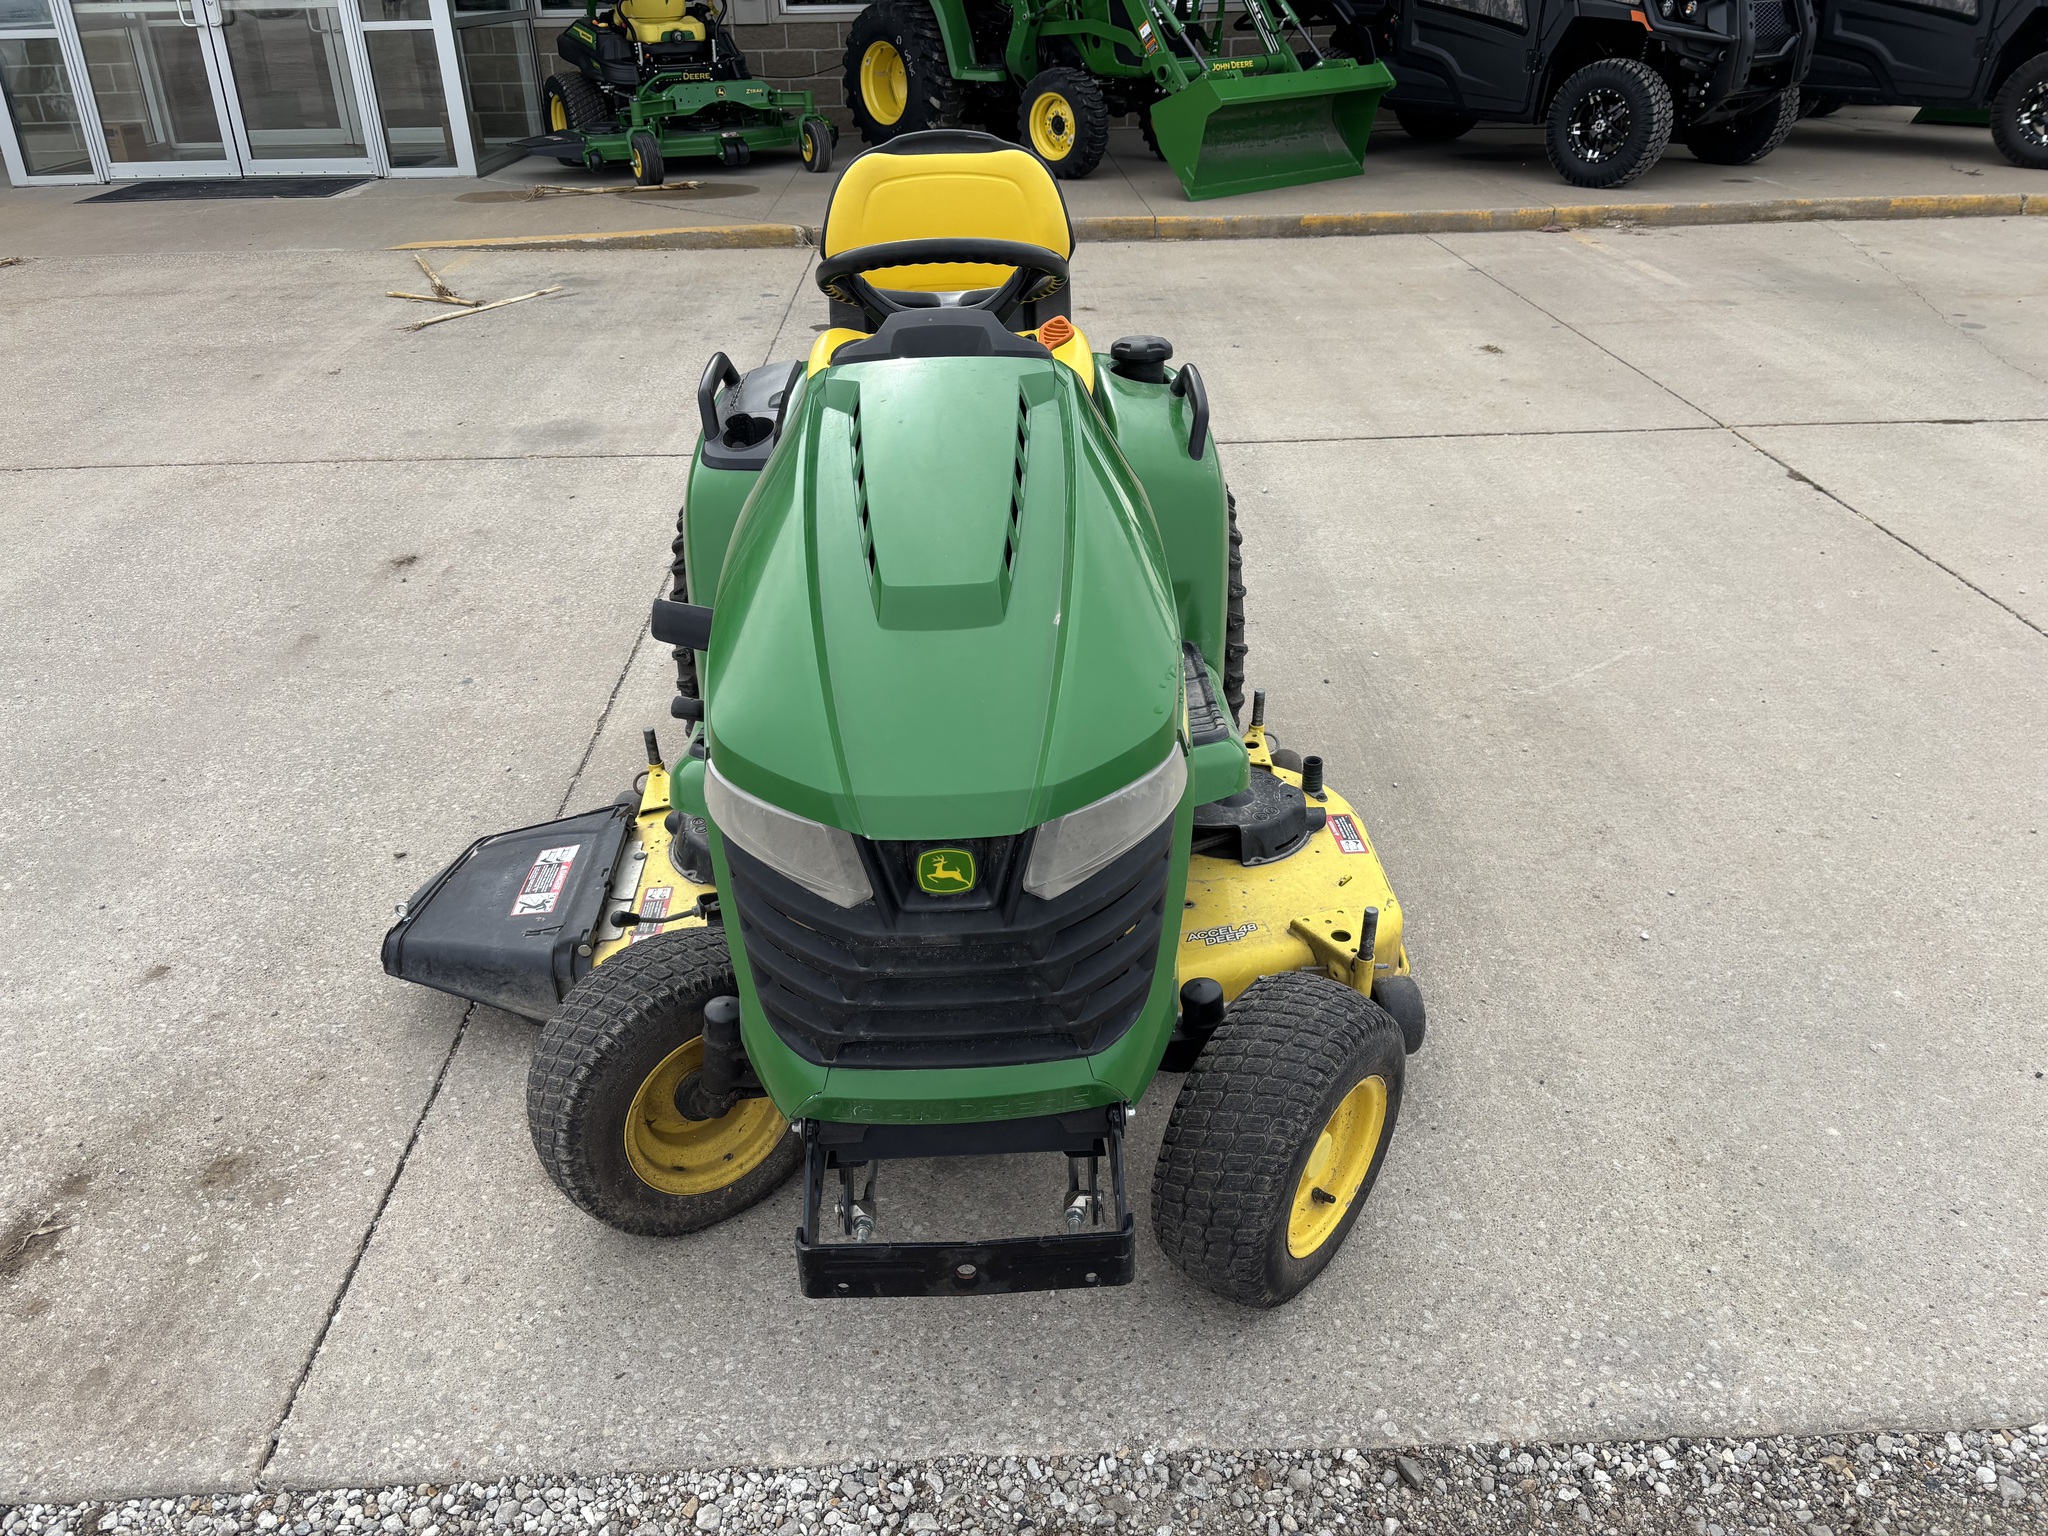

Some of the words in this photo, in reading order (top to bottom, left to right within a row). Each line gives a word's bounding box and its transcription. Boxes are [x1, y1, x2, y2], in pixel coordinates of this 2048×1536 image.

[1212, 62, 1230, 71] JOHN
[1231, 60, 1254, 69] DEERE
[683, 72, 710, 80] DEERE
[1205, 931, 1246, 946] DEEP
